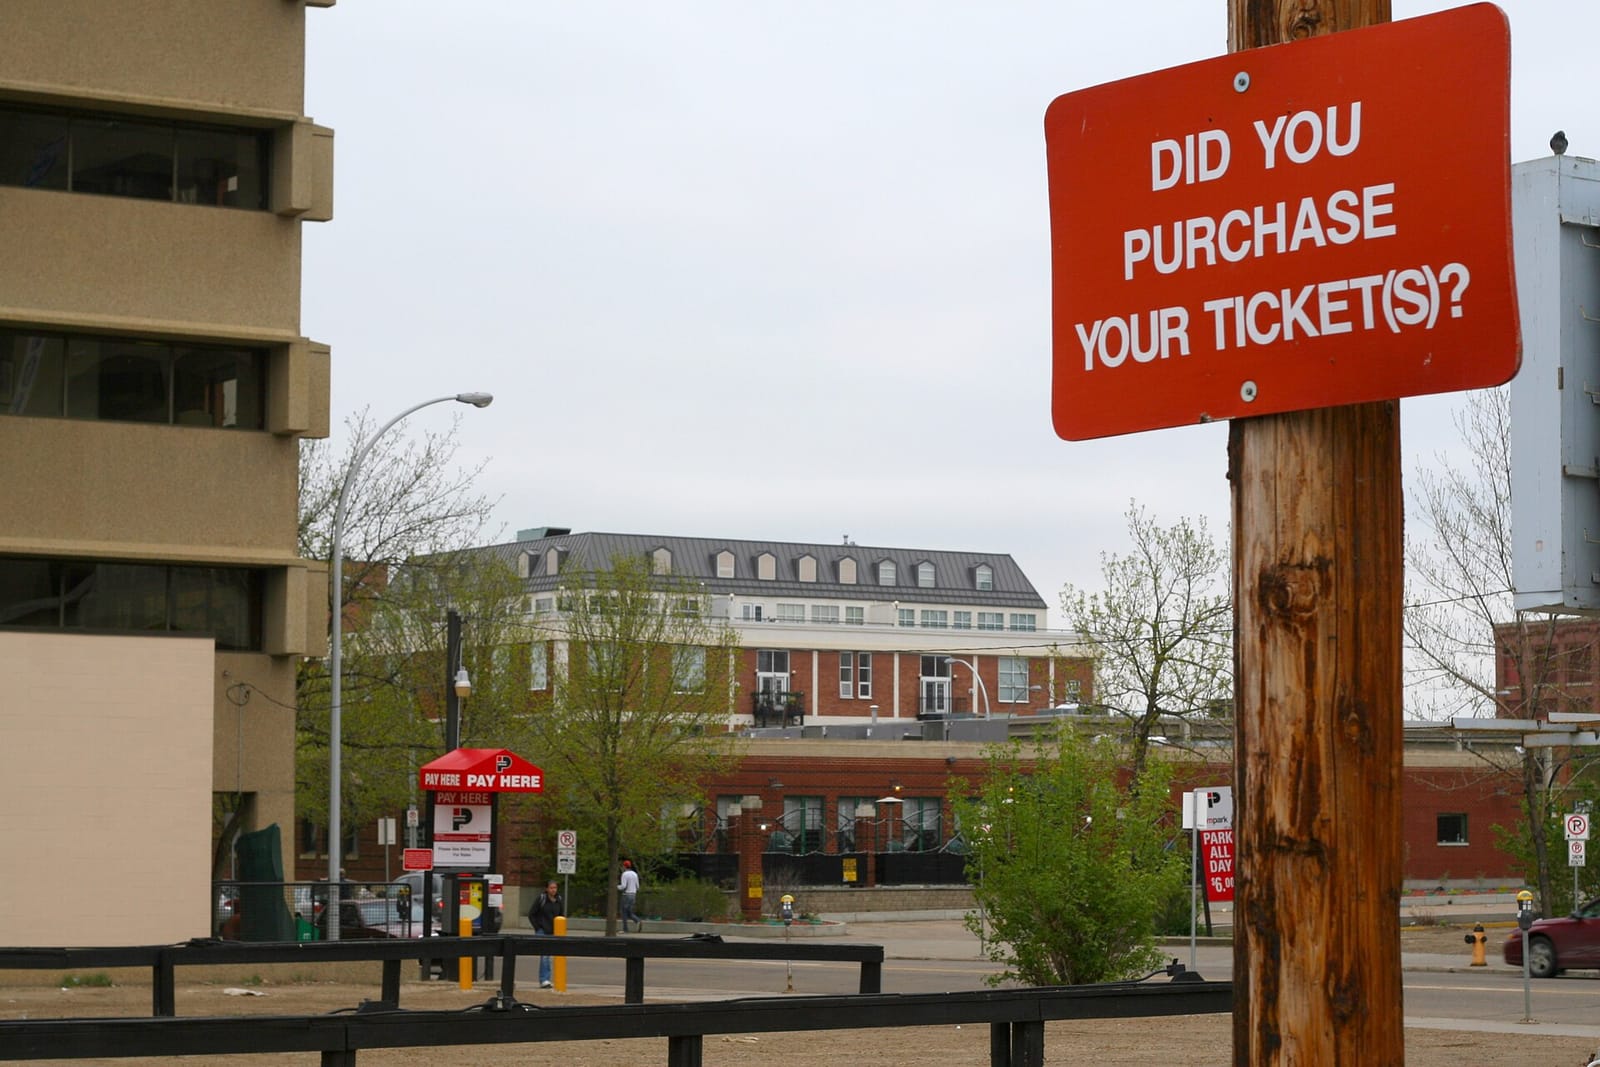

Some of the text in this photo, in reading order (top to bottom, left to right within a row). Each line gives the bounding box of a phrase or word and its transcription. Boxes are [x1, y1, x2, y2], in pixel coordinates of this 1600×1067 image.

[1151, 101, 1362, 192] DID YOU
[1123, 182, 1397, 281] PURCHASE
[1074, 262, 1471, 371] YOUR TICKET(S)?
[425, 773, 460, 786] PAY HERE
[467, 775, 541, 788] PAY HERE
[437, 792, 489, 804] PAY HERE
[1207, 816, 1229, 824] mpark
[1203, 831, 1233, 845] PARK
[1210, 846, 1231, 859] ALL
[1209, 859, 1232, 873] DAY
